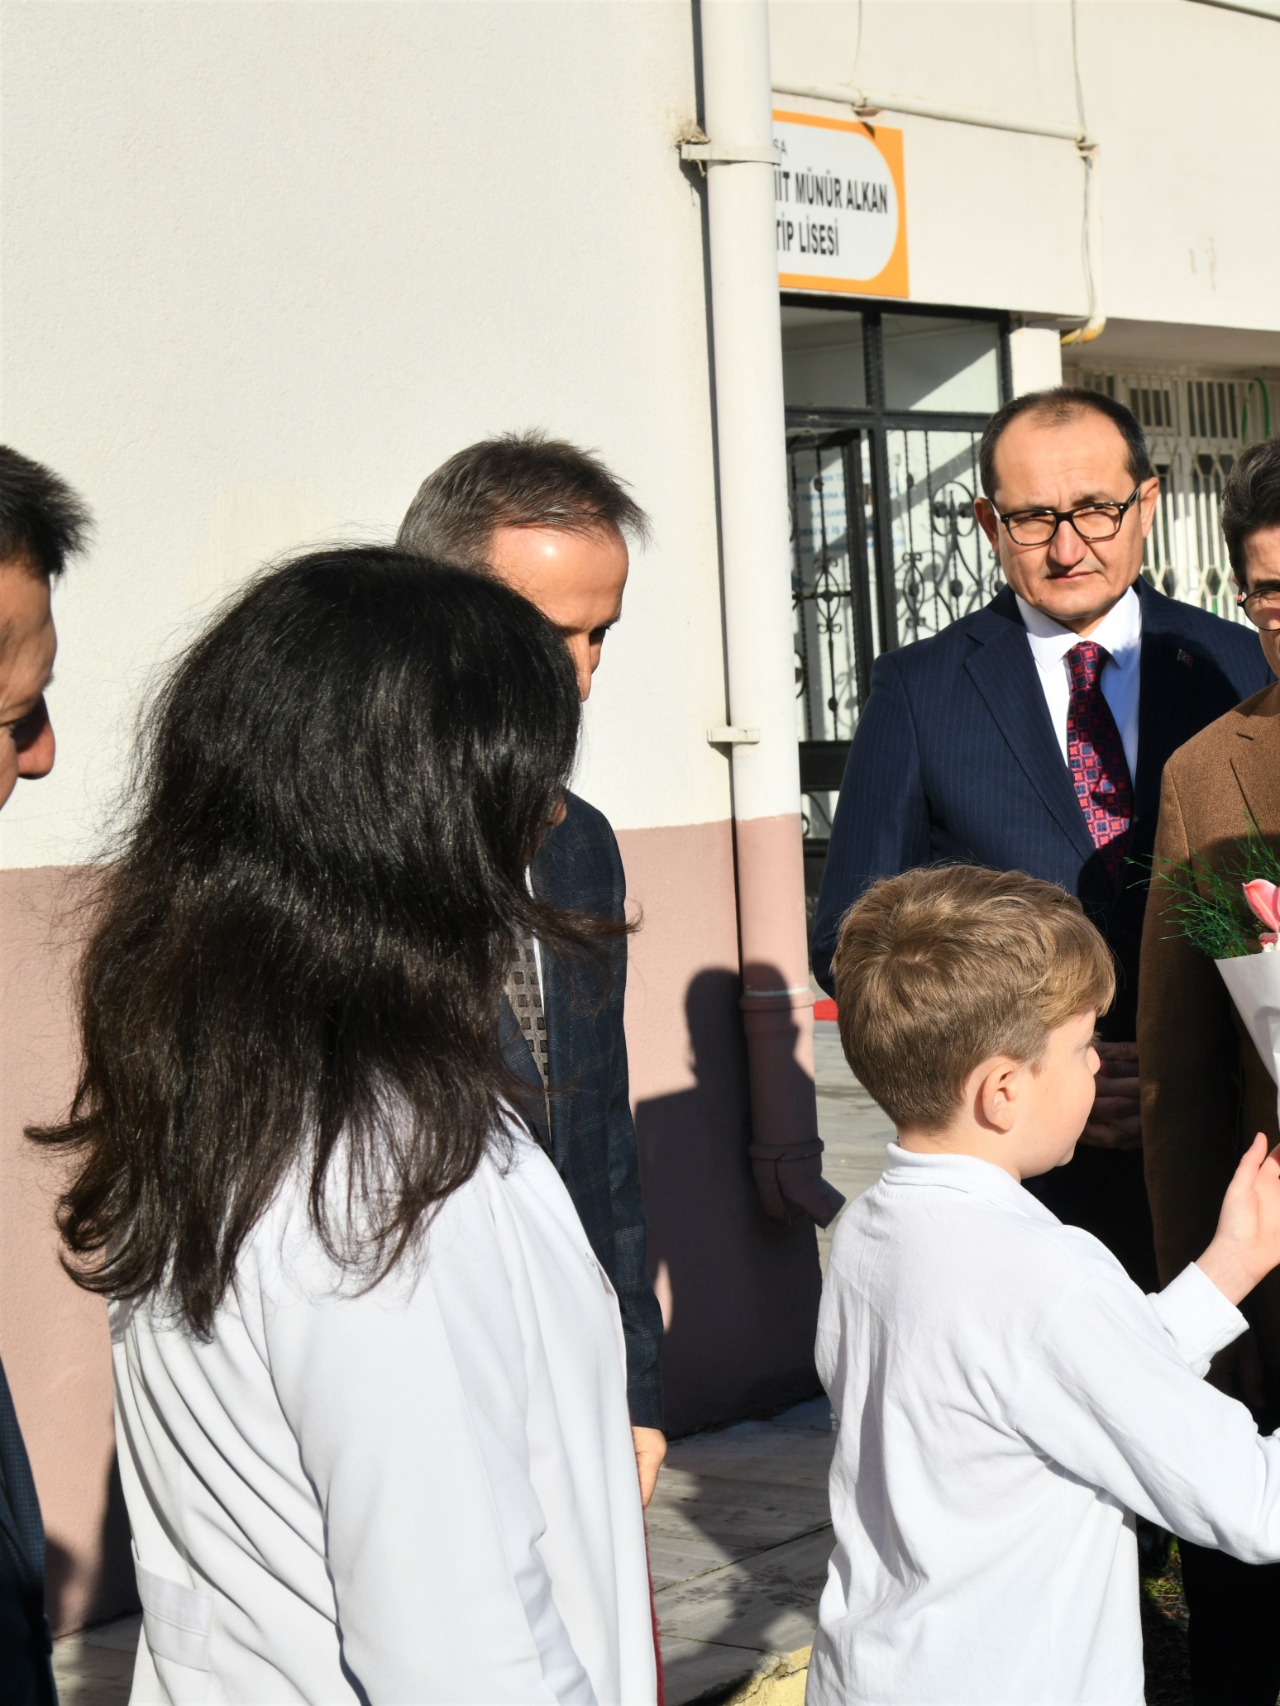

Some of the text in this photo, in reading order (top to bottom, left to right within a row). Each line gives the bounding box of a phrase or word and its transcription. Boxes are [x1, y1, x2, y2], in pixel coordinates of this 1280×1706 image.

[795, 166, 842, 209] MÜNÜR
[846, 180, 888, 214] ALKAN
[799, 214, 839, 257] LİSESİ
